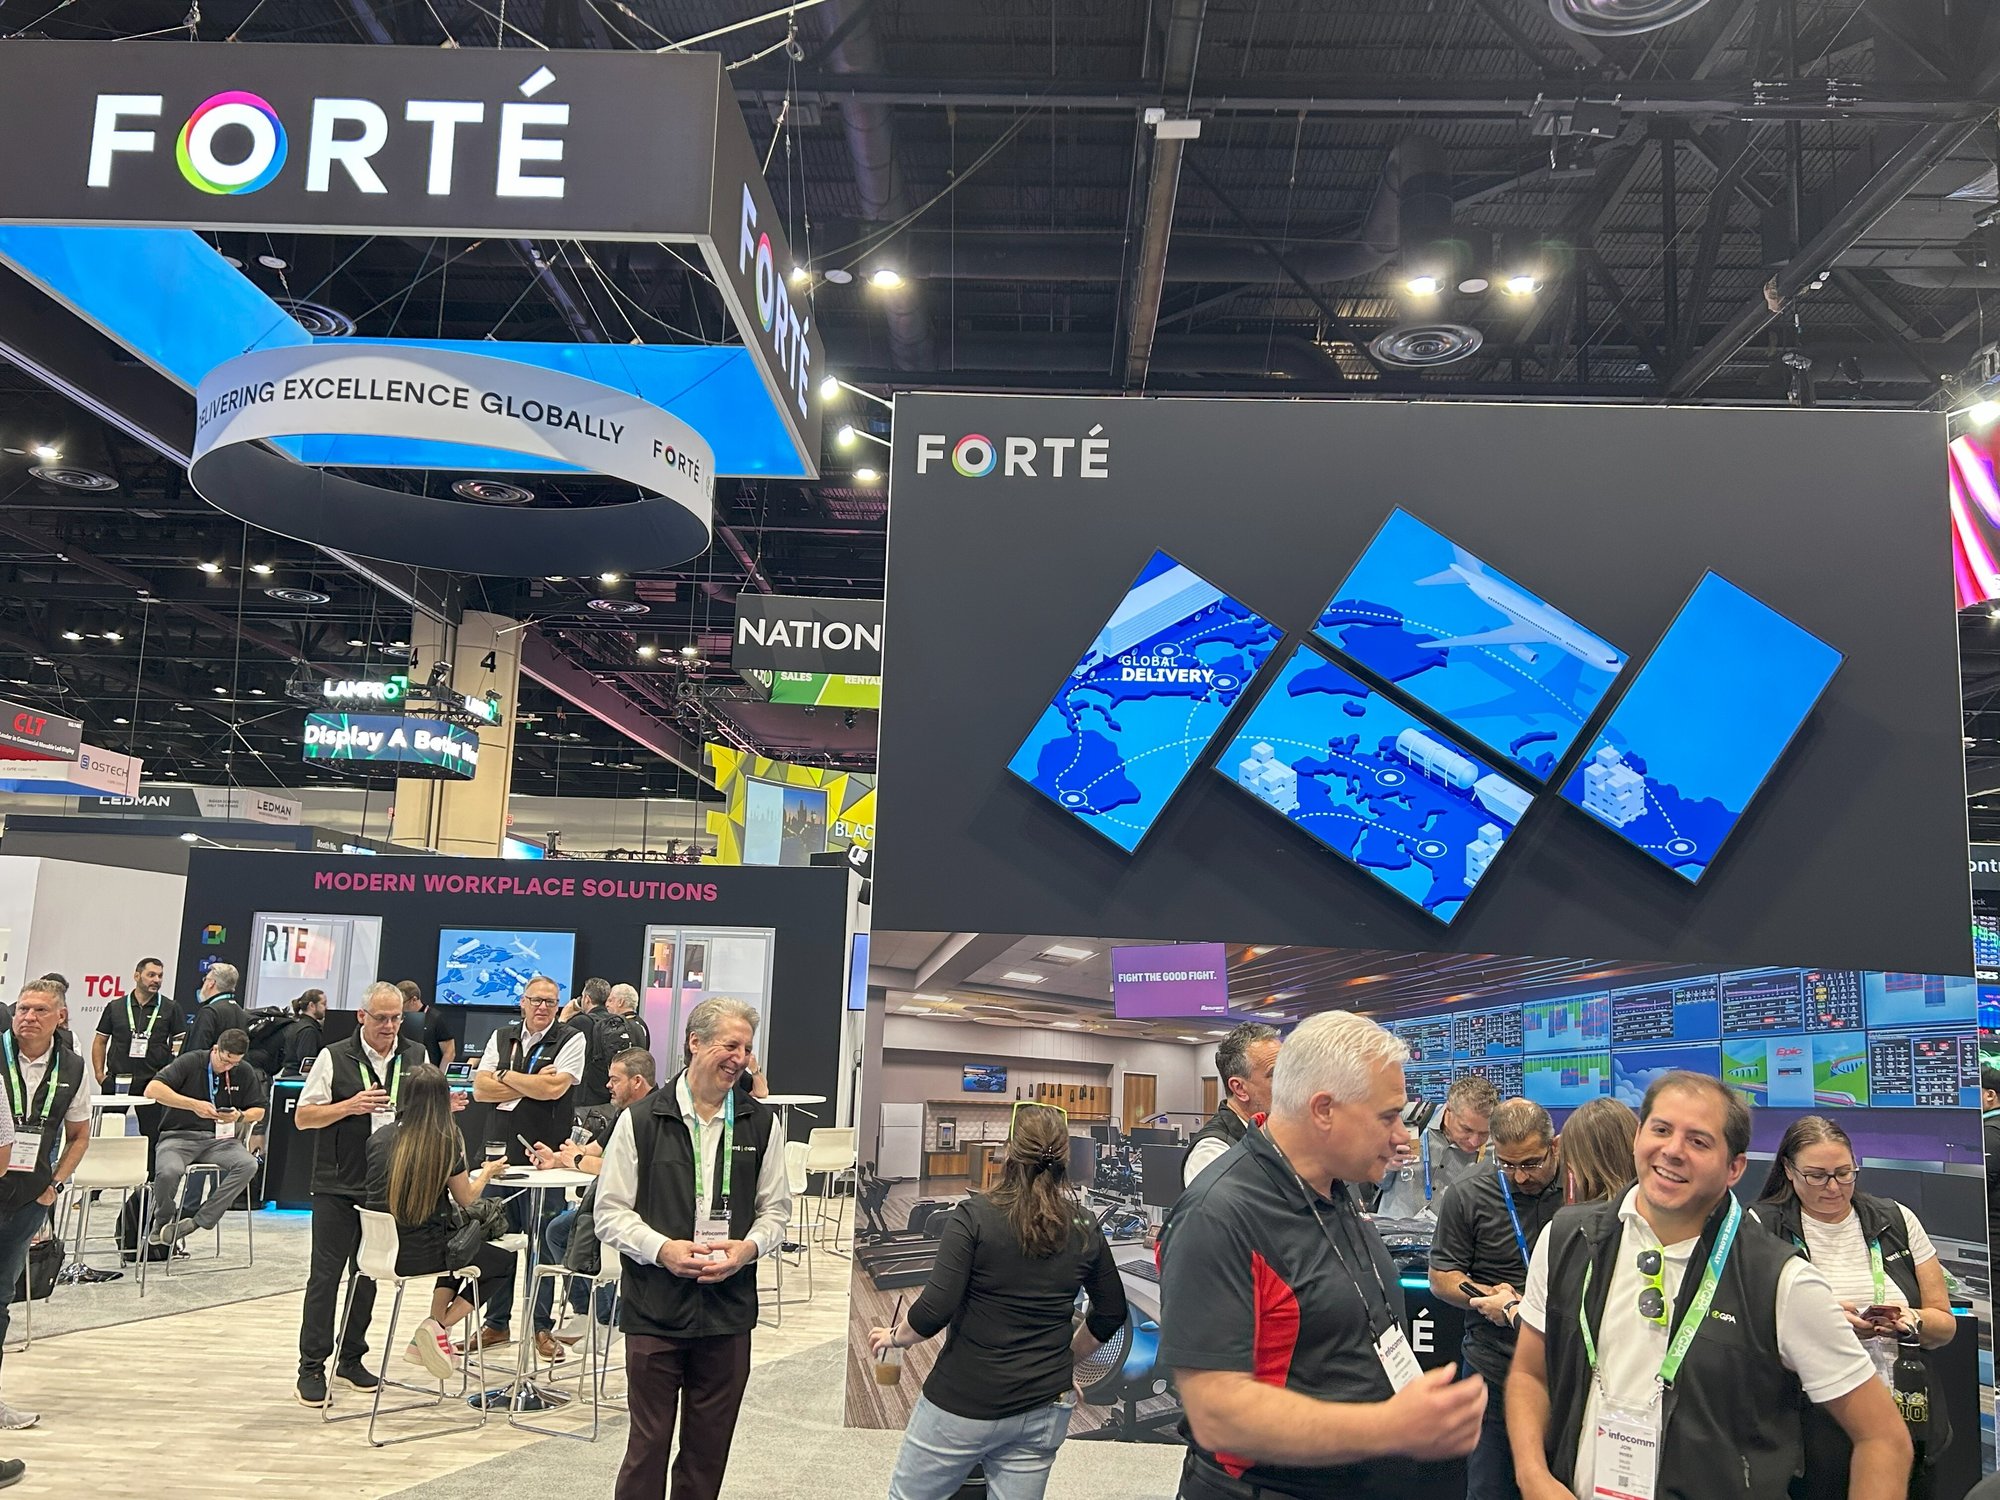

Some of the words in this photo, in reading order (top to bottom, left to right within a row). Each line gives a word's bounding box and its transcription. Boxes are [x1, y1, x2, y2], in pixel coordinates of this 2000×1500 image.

[88, 65, 570, 199] FORTÉ
[740, 182, 811, 420] FORTÉ
[284, 378, 469, 409] EXCELLENCE
[481, 392, 625, 444] GLOBALLY
[653, 439, 700, 485] FORTÉ
[917, 423, 1109, 478] FORTÉ
[738, 617, 881, 652] NATION
[480, 651, 497, 673] 4
[1121, 655, 1178, 667] GLOBAL
[780, 671, 812, 682] SALES
[1121, 667, 1215, 683] DELIVERY
[323, 677, 402, 700] LAMPRO
[13, 712, 47, 737] CLT
[304, 725, 384, 752] Display
[388, 728, 407, 748] A
[91, 760, 129, 778] QSTECH
[99, 796, 170, 808] LEDMAN
[257, 799, 292, 817] LEDMAN
[314, 871, 415, 892] MODERN
[424, 874, 576, 896] WORKPLACE
[582, 878, 718, 902] SOLUTIONS
[85, 975, 125, 998] TCL
[1118, 973, 1143, 983] FIGHT
[1144, 972, 1162, 982] THE
[1162, 971, 1187, 981] GOOD
[1188, 970, 1217, 980] FIGHT.
[284, 1098, 296, 1114] F
[1412, 1307, 1435, 1353] É
[1719, 1313, 1737, 1324] GPA
[1608, 1429, 1656, 1448] infocomm
